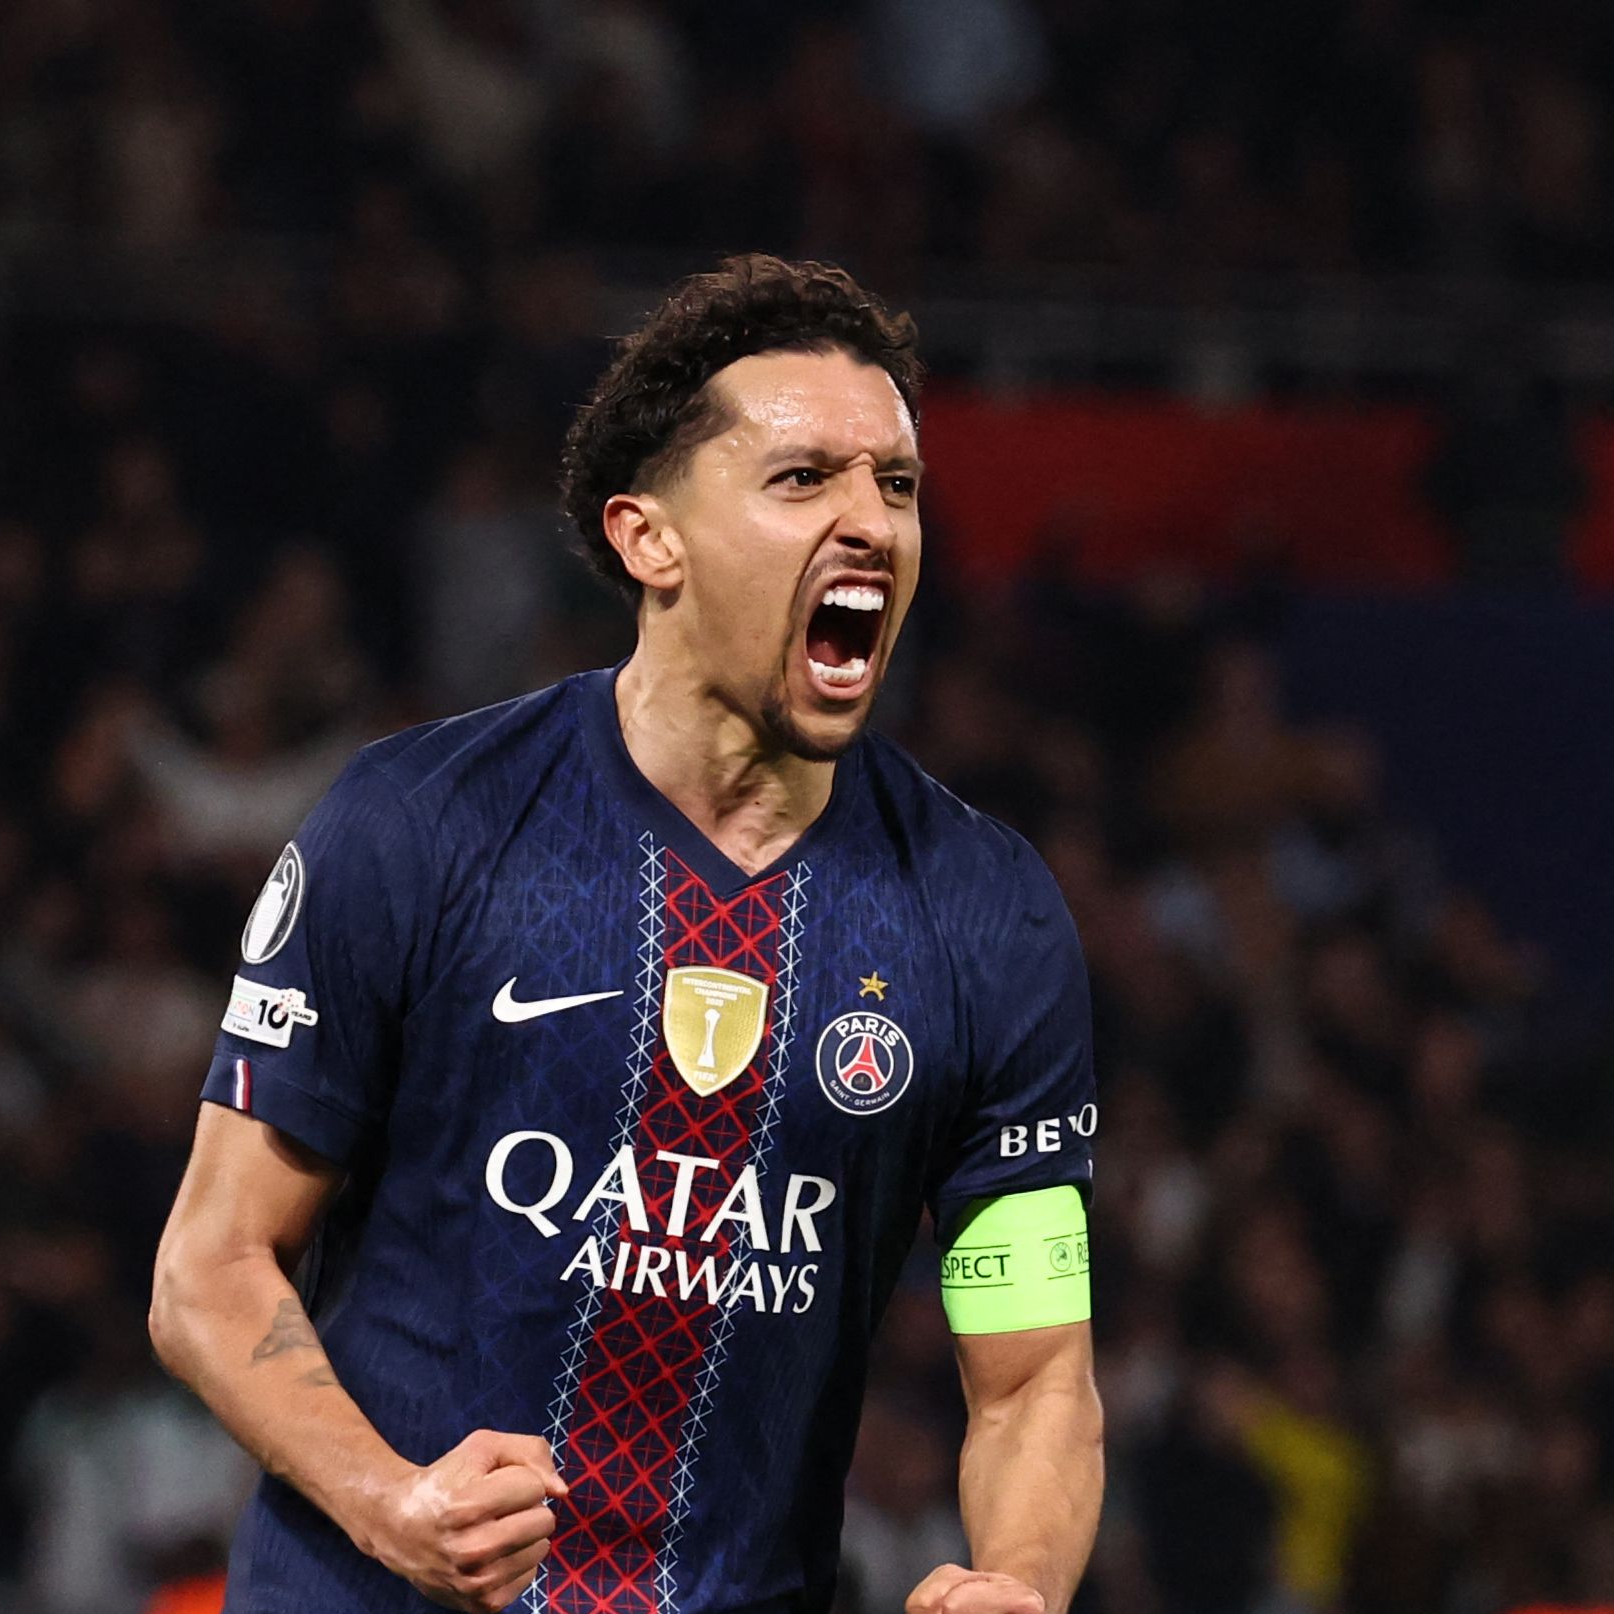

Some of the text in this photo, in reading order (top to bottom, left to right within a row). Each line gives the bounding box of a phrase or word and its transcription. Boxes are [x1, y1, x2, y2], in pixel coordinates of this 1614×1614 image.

[835, 1017, 900, 1047] PARIS
[485, 1130, 836, 1254] QATAR
[559, 1235, 819, 1314] AIRWAYS
